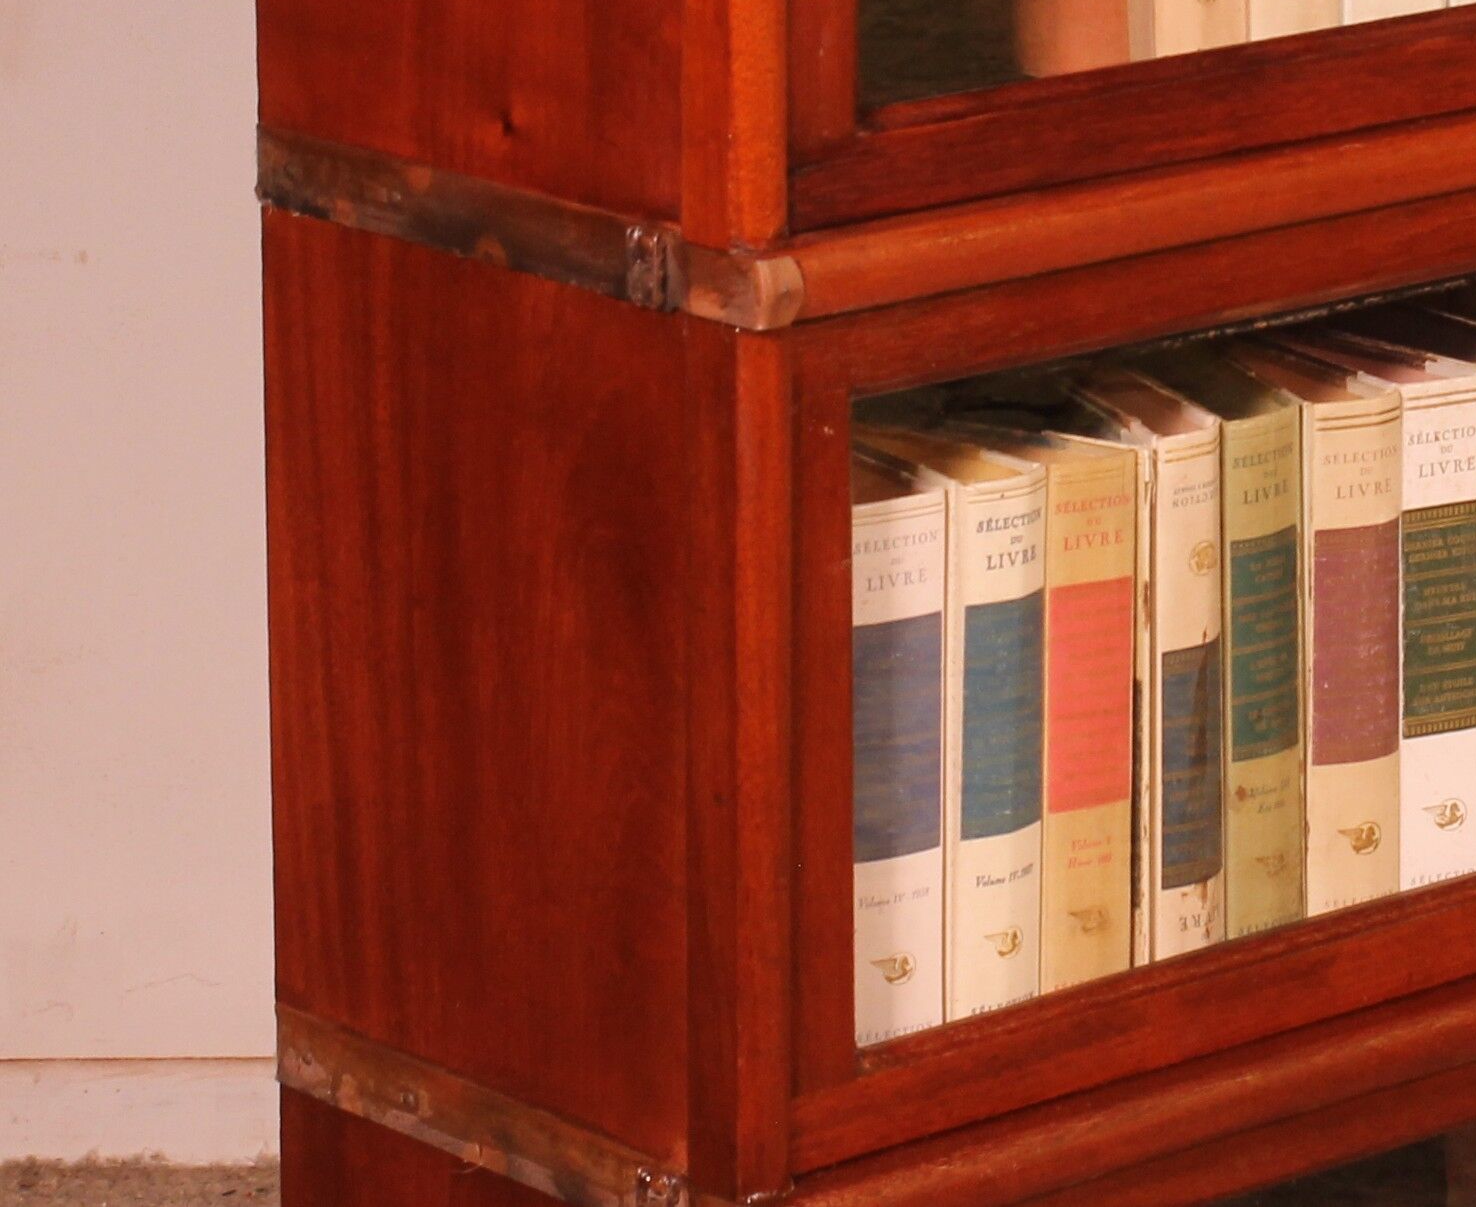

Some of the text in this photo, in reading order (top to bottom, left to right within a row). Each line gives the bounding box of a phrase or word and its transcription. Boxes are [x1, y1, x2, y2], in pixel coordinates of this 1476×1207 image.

[1419, 456, 1476, 478] LIVRE
[1242, 479, 1289, 505] LIVRE
[1335, 479, 1393, 500] LIVRE
[976, 506, 1042, 534] SÉLECTION
[1064, 529, 1123, 552] LIVRE
[986, 545, 1037, 571] LIVRE
[867, 568, 928, 592] LIVRE
[976, 875, 1005, 888] Volume
[859, 894, 890, 909] Volume
